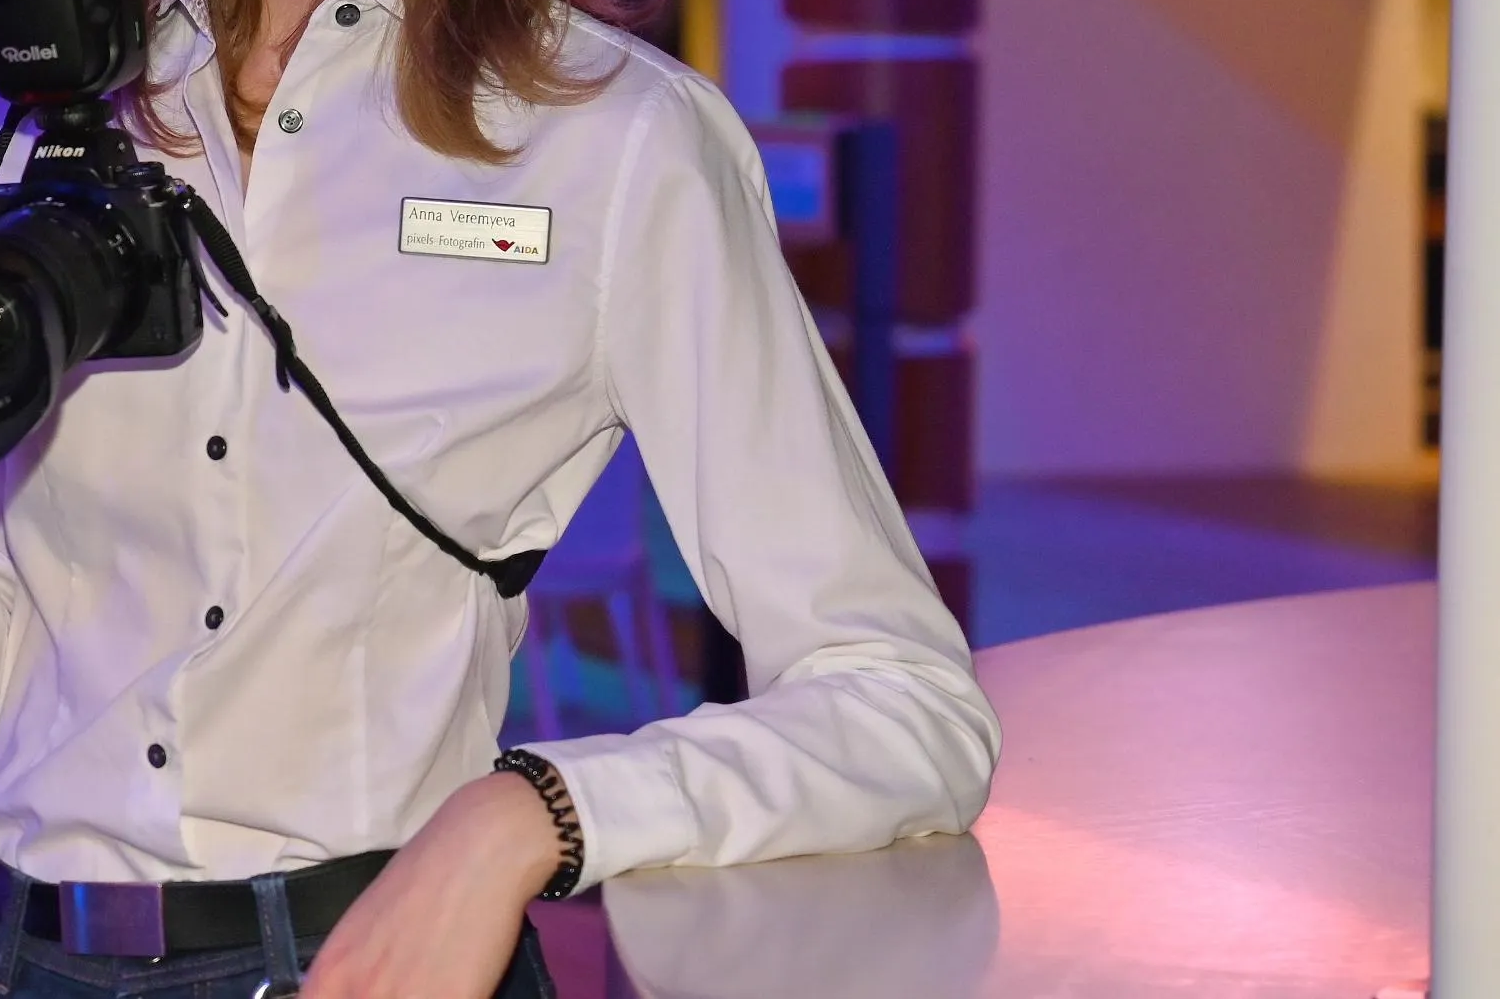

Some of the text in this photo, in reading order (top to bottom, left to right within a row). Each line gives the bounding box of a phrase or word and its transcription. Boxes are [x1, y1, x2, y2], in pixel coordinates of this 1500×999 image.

[1, 43, 58, 62] Rollei
[34, 145, 86, 159] Nikon
[408, 207, 516, 229] Anna Veremyeva
[406, 233, 485, 250] pixels Fotografin
[513, 246, 539, 255] AIDA
